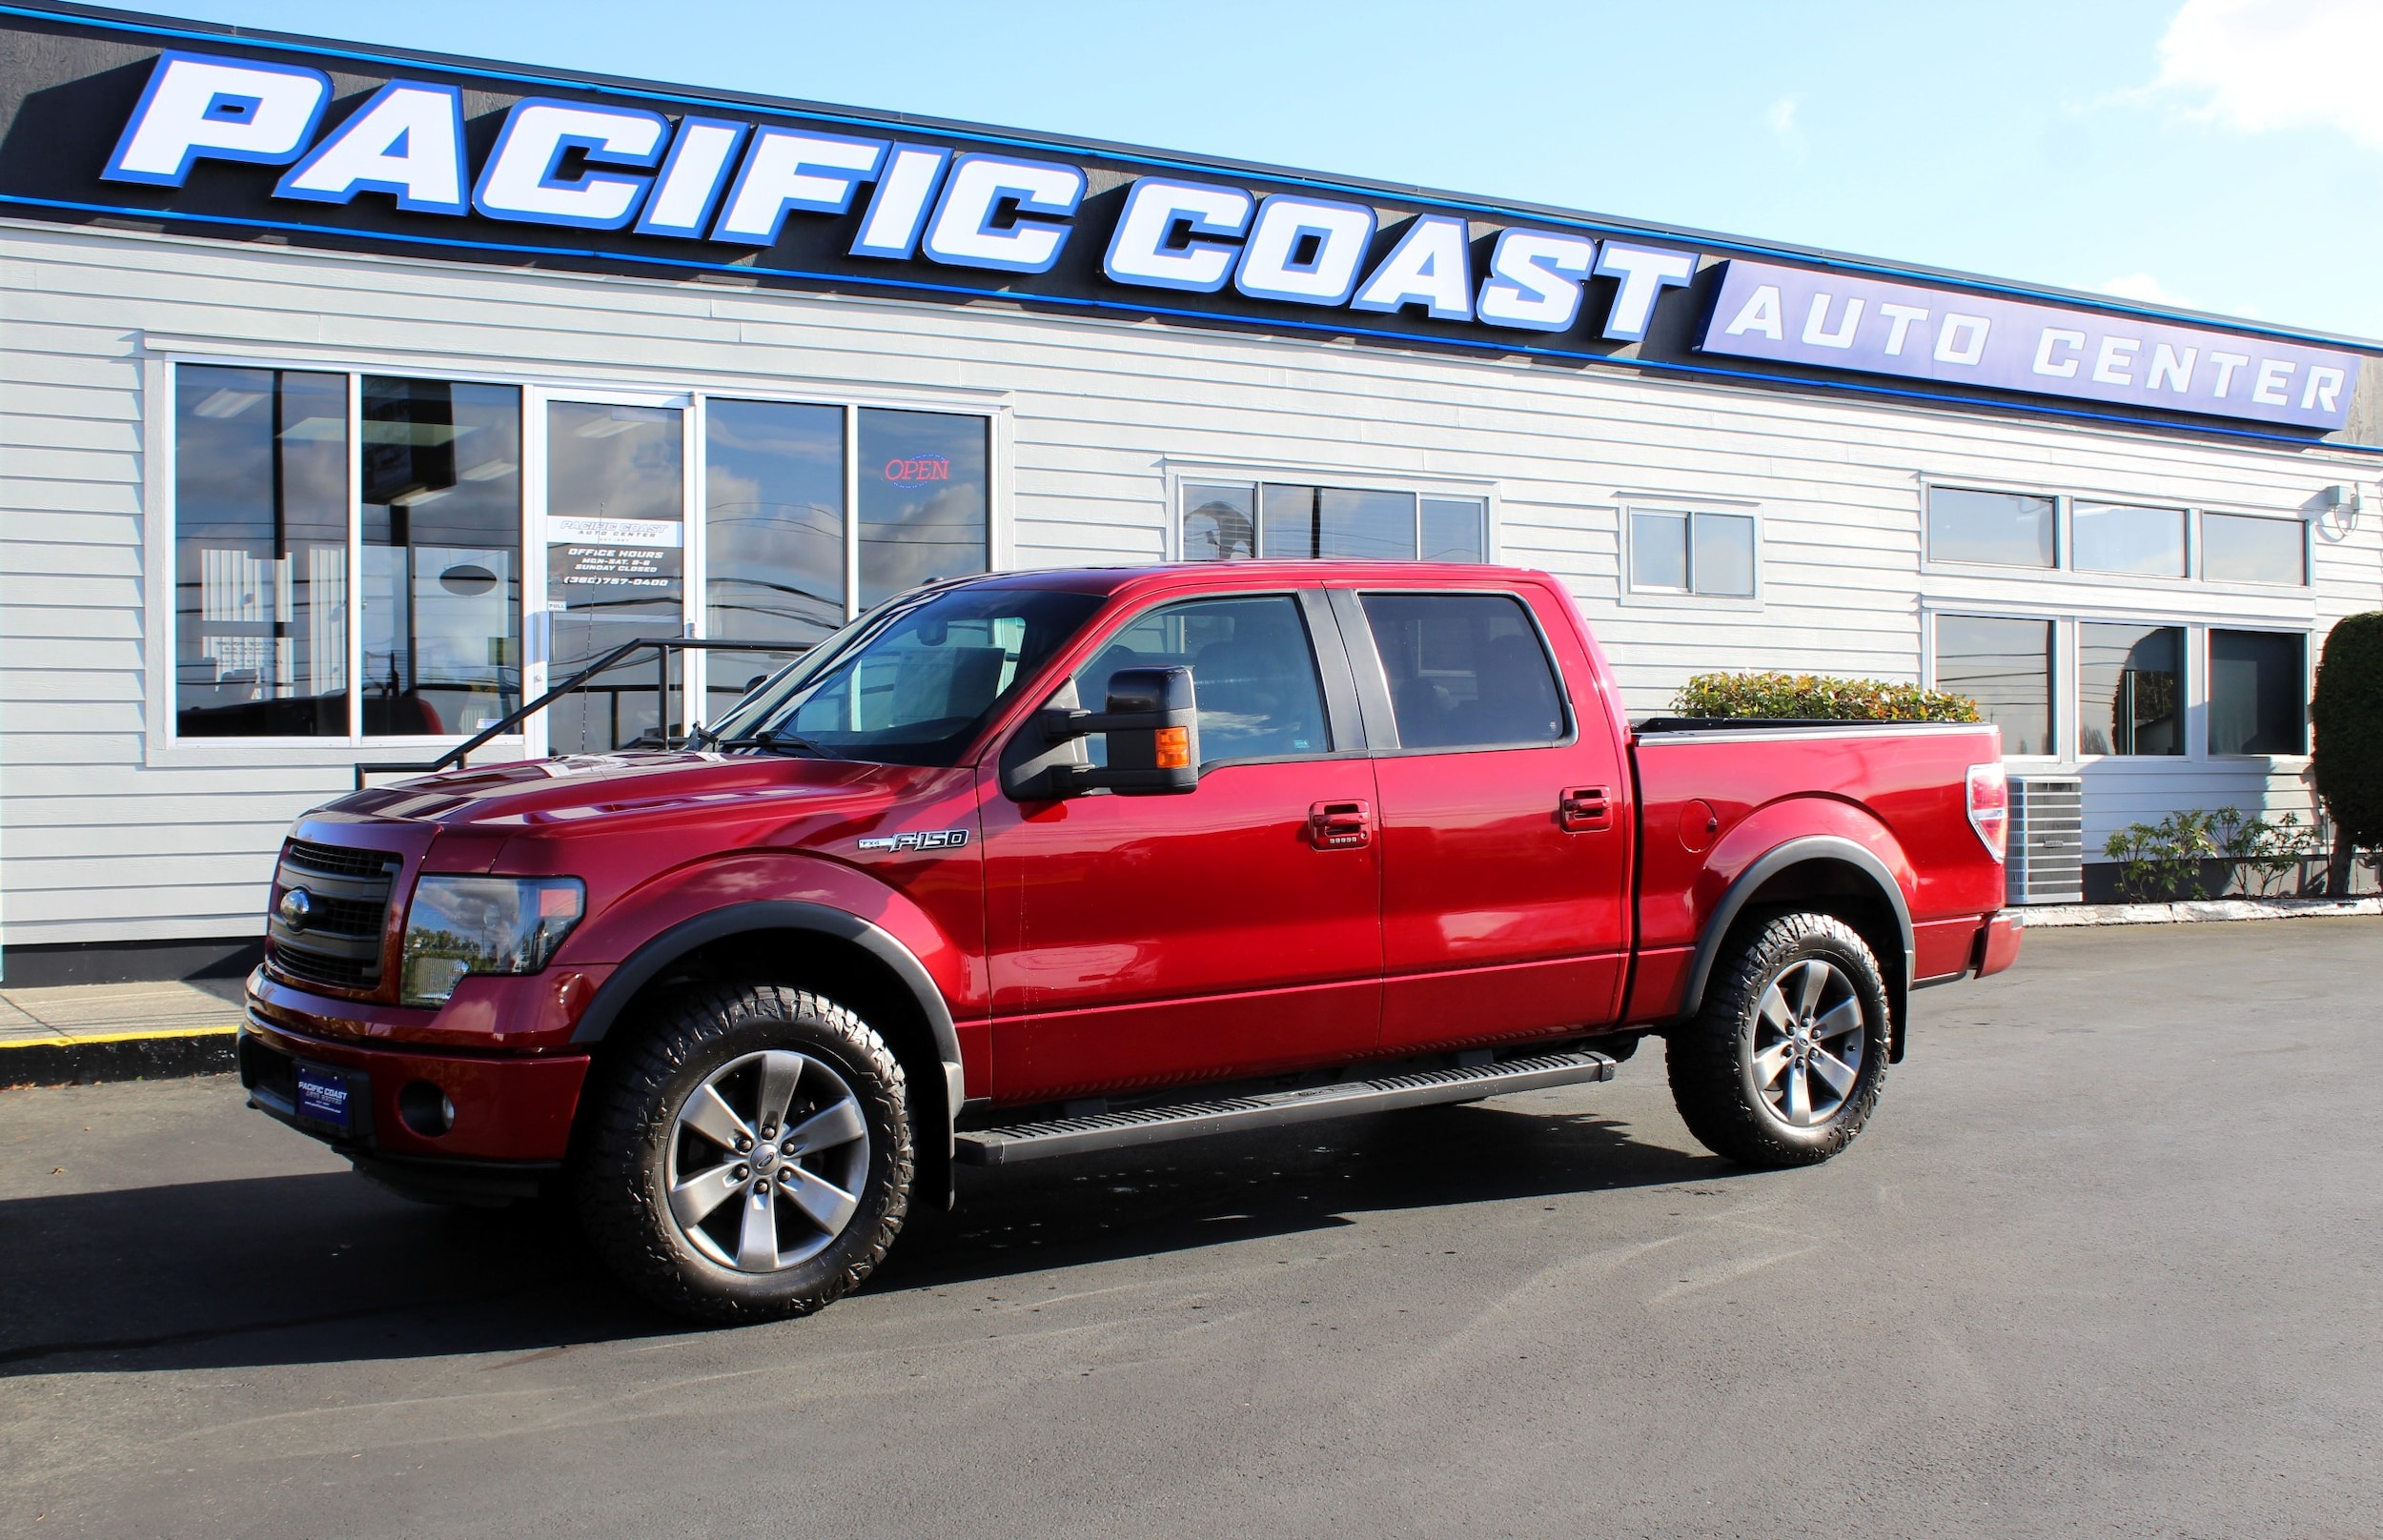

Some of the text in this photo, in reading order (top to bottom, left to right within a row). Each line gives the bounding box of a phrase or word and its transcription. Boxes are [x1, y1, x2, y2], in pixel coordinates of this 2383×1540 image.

[101, 50, 1701, 341] PACIFIC COAST
[1724, 285, 2346, 413] AUTO CENTER
[885, 458, 950, 481] OPEN
[560, 521, 668, 533] PACIFIC COAST
[567, 548, 664, 558] OFFICE HOURS
[564, 577, 668, 586] (360)757-0400
[888, 829, 969, 853] F-150
[298, 1082, 324, 1094] PACIFIC
[324, 1087, 348, 1101] COAST
